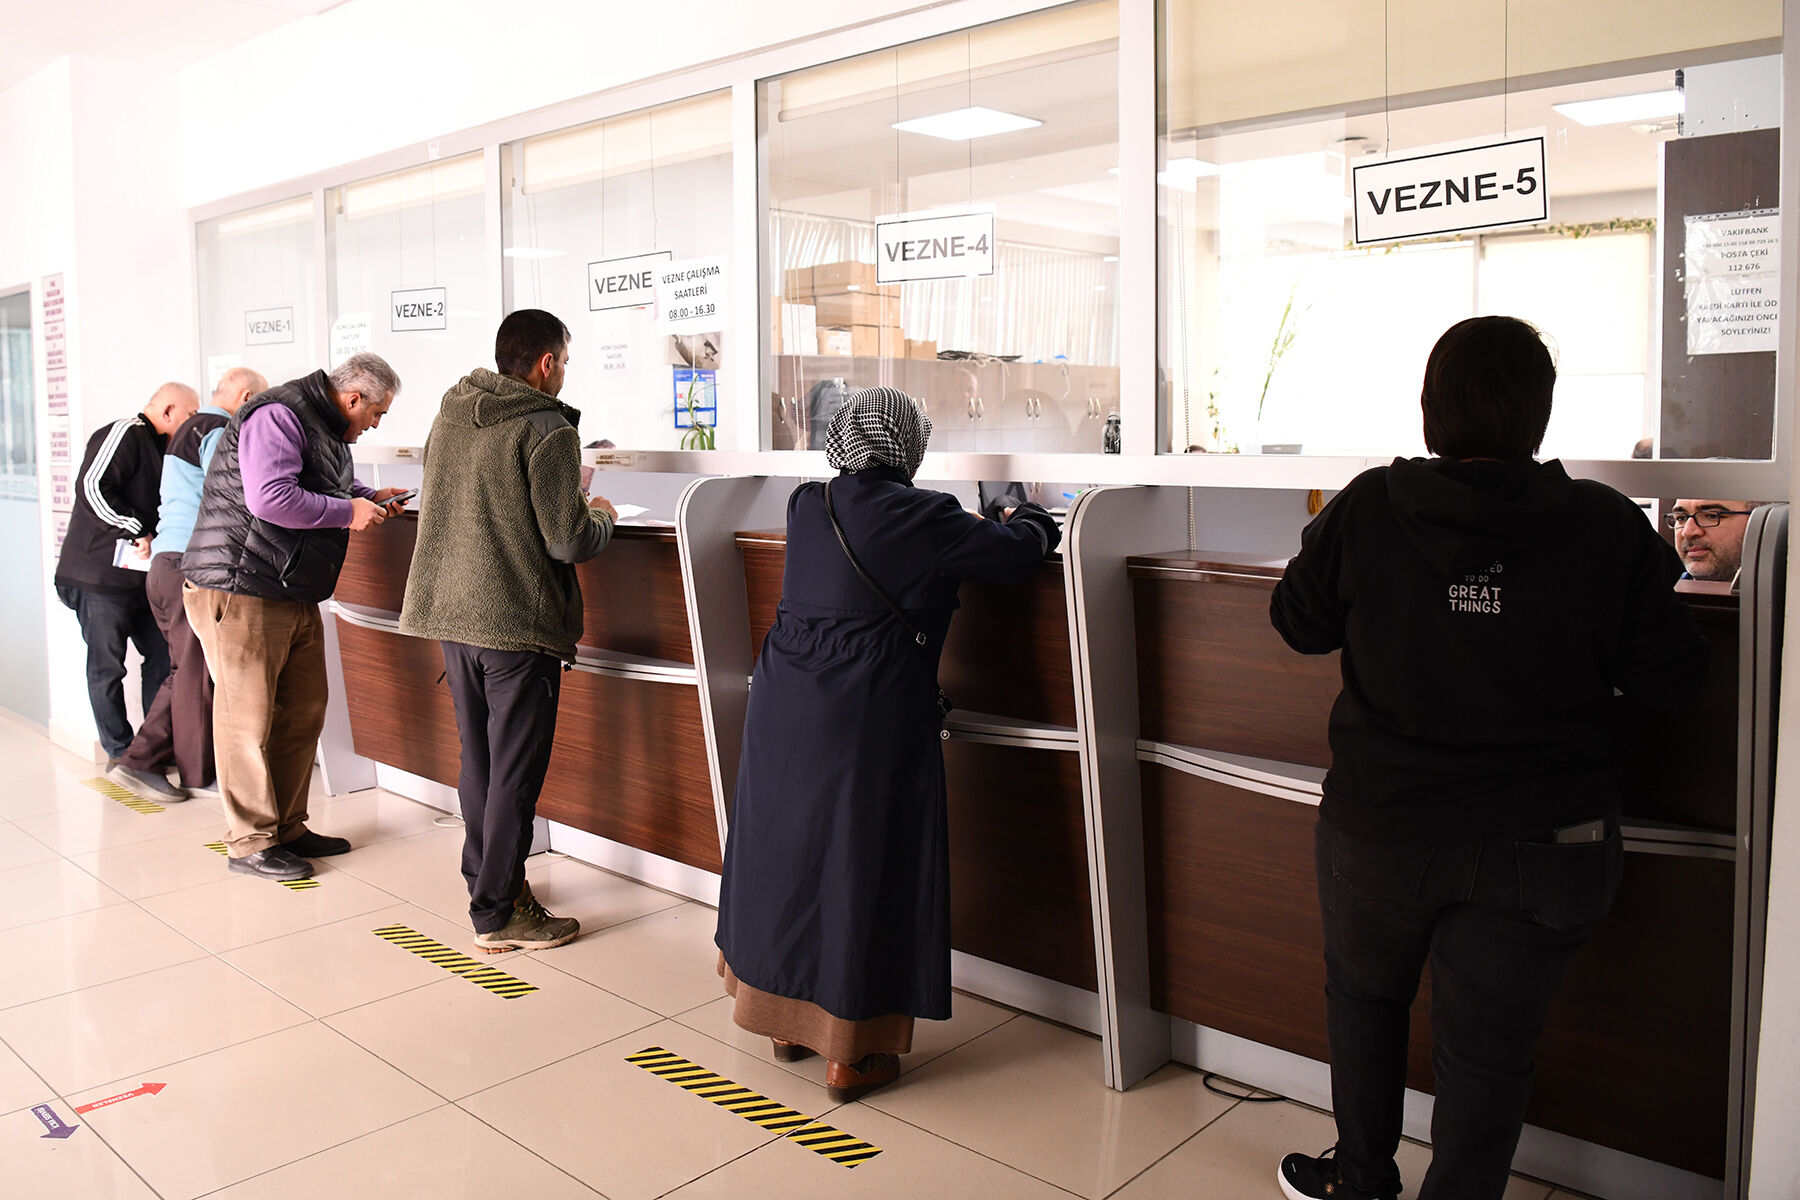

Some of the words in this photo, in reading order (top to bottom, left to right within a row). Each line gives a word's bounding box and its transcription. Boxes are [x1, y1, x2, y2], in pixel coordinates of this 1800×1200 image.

[1367, 166, 1537, 215] VEZNE-5
[885, 233, 989, 262] VEZNE-4
[1721, 250, 1748, 259] POSTA
[1750, 248, 1769, 258] ÇEKİ
[662, 271, 685, 285] VEZNE
[686, 265, 721, 283] ÇALIŞMA
[674, 283, 708, 300] SAATLERİ
[395, 302, 444, 318] VEZNE-2
[669, 307, 689, 319] 08.00
[695, 303, 716, 316] 16.30
[248, 319, 291, 334] VEZNE-1
[1464, 574, 1476, 583] TO
[1478, 575, 1490, 583] DO
[1448, 584, 1502, 600] GREAT
[1448, 599, 1502, 614] THINGS
